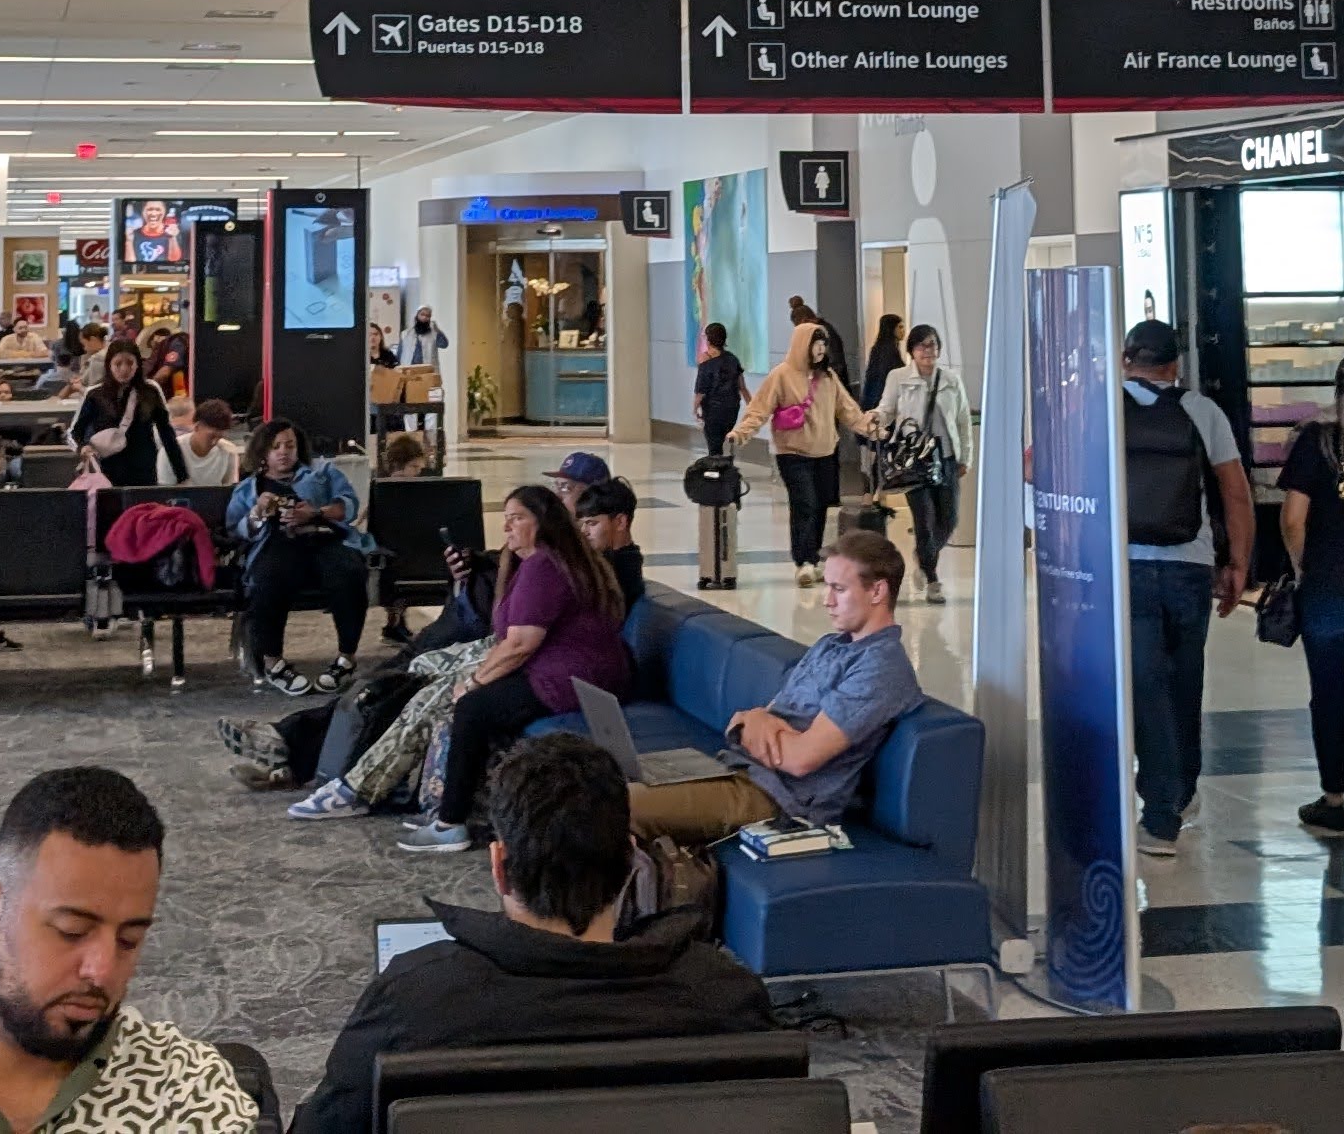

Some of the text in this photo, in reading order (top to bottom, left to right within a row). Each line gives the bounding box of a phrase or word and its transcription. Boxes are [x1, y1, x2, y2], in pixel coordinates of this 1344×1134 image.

[790, 0, 980, 24] KLM Crown Lounge
[417, 15, 584, 35] Gates D15-D18
[1253, 17, 1296, 31] Baños
[417, 40, 545, 55] Puertas D15-D18
[790, 50, 1009, 74] Other Airline Lounges
[1123, 51, 1298, 73] Air France Lounge
[1240, 128, 1330, 172] CHANEL
